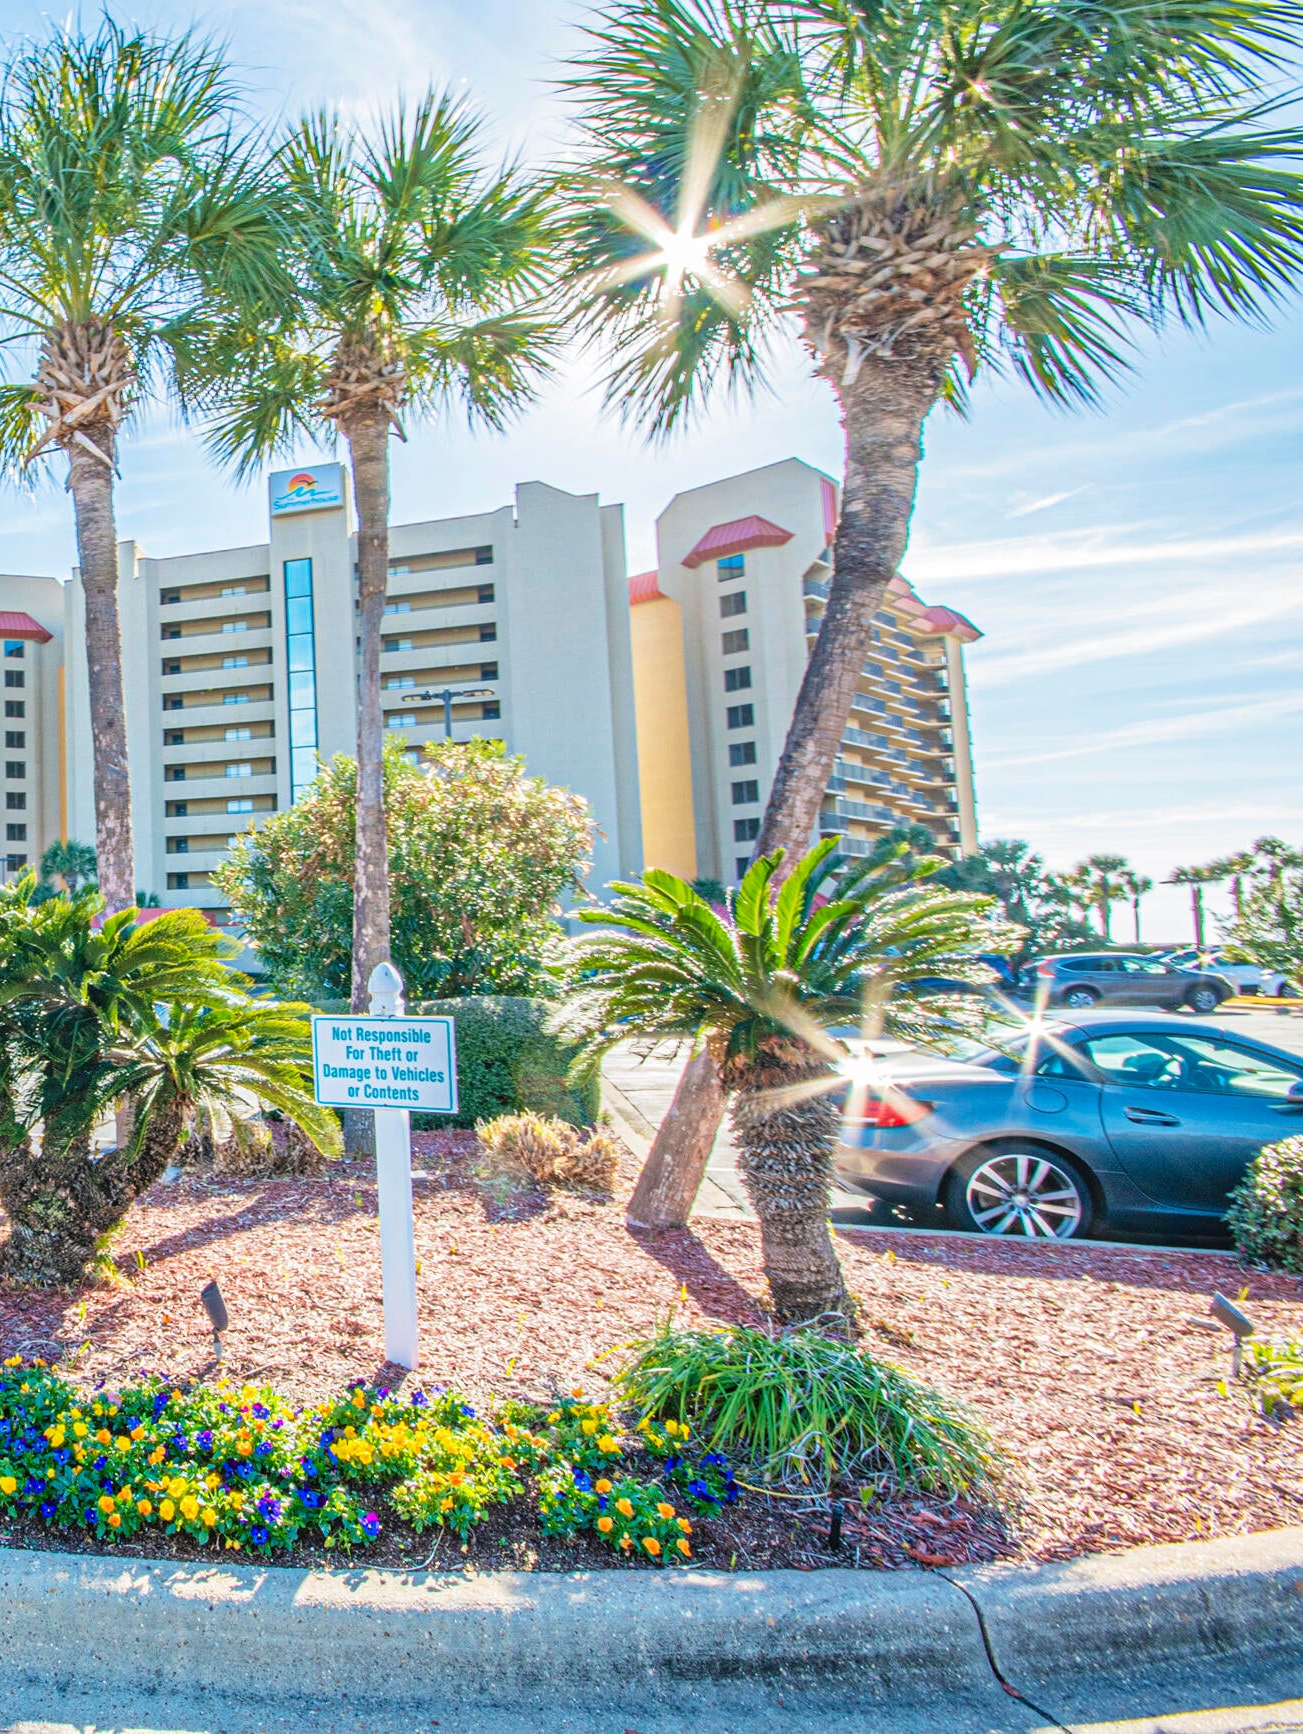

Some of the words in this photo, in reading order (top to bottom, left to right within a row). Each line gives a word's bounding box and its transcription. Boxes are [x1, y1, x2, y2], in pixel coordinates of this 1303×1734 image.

[332, 1026, 353, 1041] Not
[356, 1027, 431, 1044] Responsible
[346, 1046, 364, 1060] For
[369, 1047, 402, 1062] Theft
[405, 1050, 418, 1062] or
[323, 1064, 371, 1082] Damage
[375, 1066, 388, 1080] to
[392, 1067, 444, 1083] Vehicles
[348, 1086, 360, 1097] or
[364, 1084, 419, 1101] Contents
